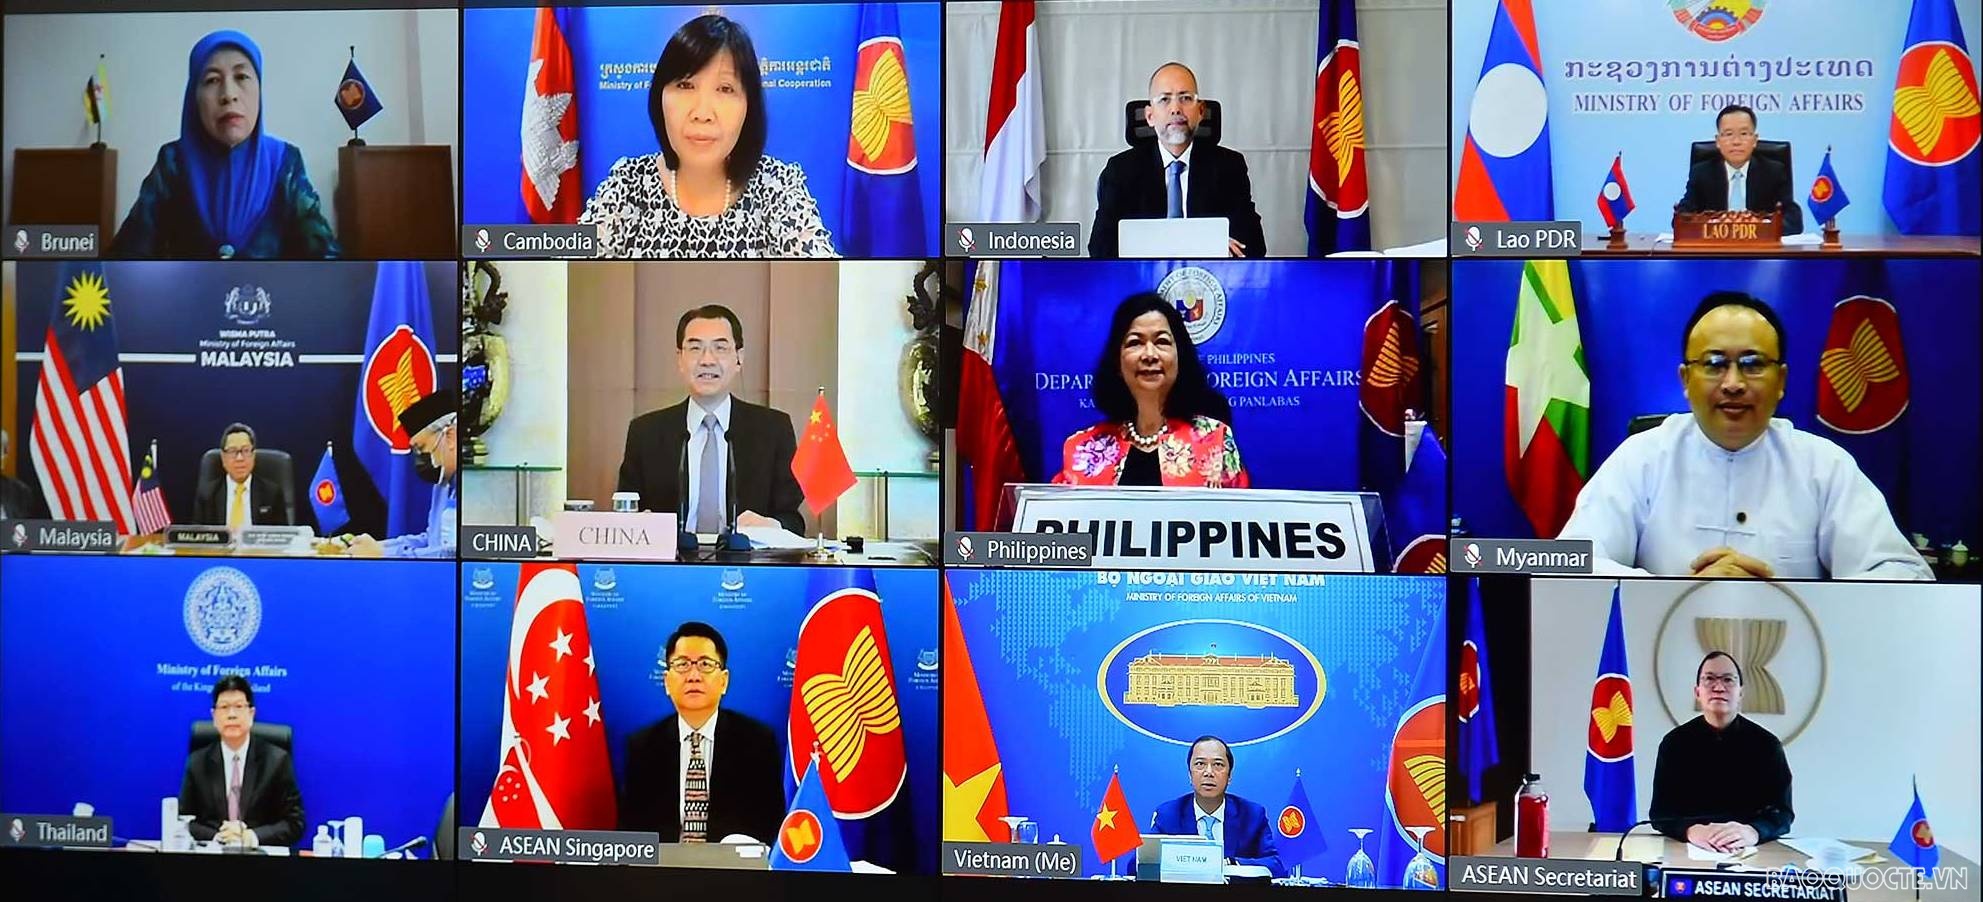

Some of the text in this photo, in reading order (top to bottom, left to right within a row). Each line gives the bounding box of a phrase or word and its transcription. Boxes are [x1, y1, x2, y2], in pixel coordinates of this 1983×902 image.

[600, 81, 632, 91] Ministry
[633, 80, 643, 89] of
[778, 78, 831, 89] Cooperation
[1574, 94, 1864, 111] MINISTRY OF FOREIGN AFFAIRS
[503, 231, 592, 250] Cambodia
[989, 231, 1075, 249] Indonesia
[1497, 229, 1577, 248] Lao PDR
[1703, 224, 1757, 239] LAO PDR
[41, 232, 94, 251] Brunei
[219, 330, 276, 338] WISMA PUTRA
[200, 340, 296, 349] Ministry of Foreign Affairs
[201, 351, 294, 367] MALAYSIA
[1207, 353, 1275, 364] PHILIPPINES
[1035, 372, 1094, 390] DEPAR
[1207, 371, 1278, 388] OREIGN
[1239, 396, 1300, 407] PANLABAS
[39, 527, 111, 550] Malaysia
[178, 532, 219, 542] MALAYSIA
[473, 533, 531, 551] CHINA
[579, 527, 650, 545] CHINA
[988, 540, 1087, 563] Philippines
[1497, 548, 1588, 570] Myanmar
[1191, 572, 1235, 586] GIAO
[1284, 574, 1326, 586] NAM
[1126, 592, 1297, 602] MINISTRY OF FOREIGN AFFAIRS OF VIETNAM
[157, 663, 287, 677] Ministry of Foreign Affairs
[37, 822, 107, 842] Thailand
[500, 836, 654, 862] ASEAN Singapore
[954, 849, 1076, 873] Vietnam (Me)
[1462, 865, 1637, 888] ASEAN Secretariat
[1695, 880, 1835, 900] ASEAN SECRETARIAT
